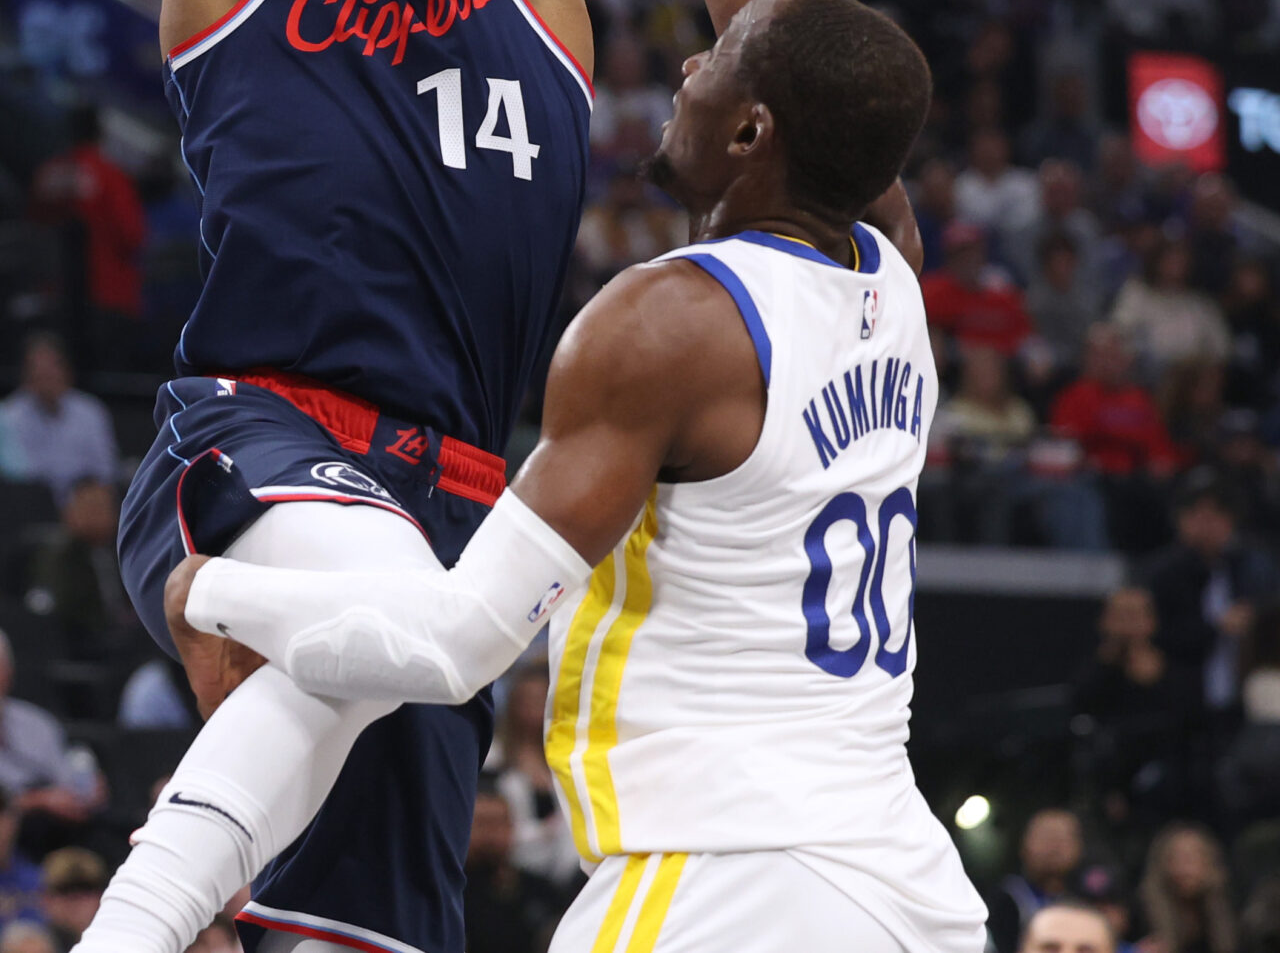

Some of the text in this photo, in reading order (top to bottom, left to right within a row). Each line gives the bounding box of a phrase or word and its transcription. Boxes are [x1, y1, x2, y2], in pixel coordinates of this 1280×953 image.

[417, 68, 541, 181] 14
[802, 357, 924, 470] KUMINGA
[801, 486, 918, 678] 00
